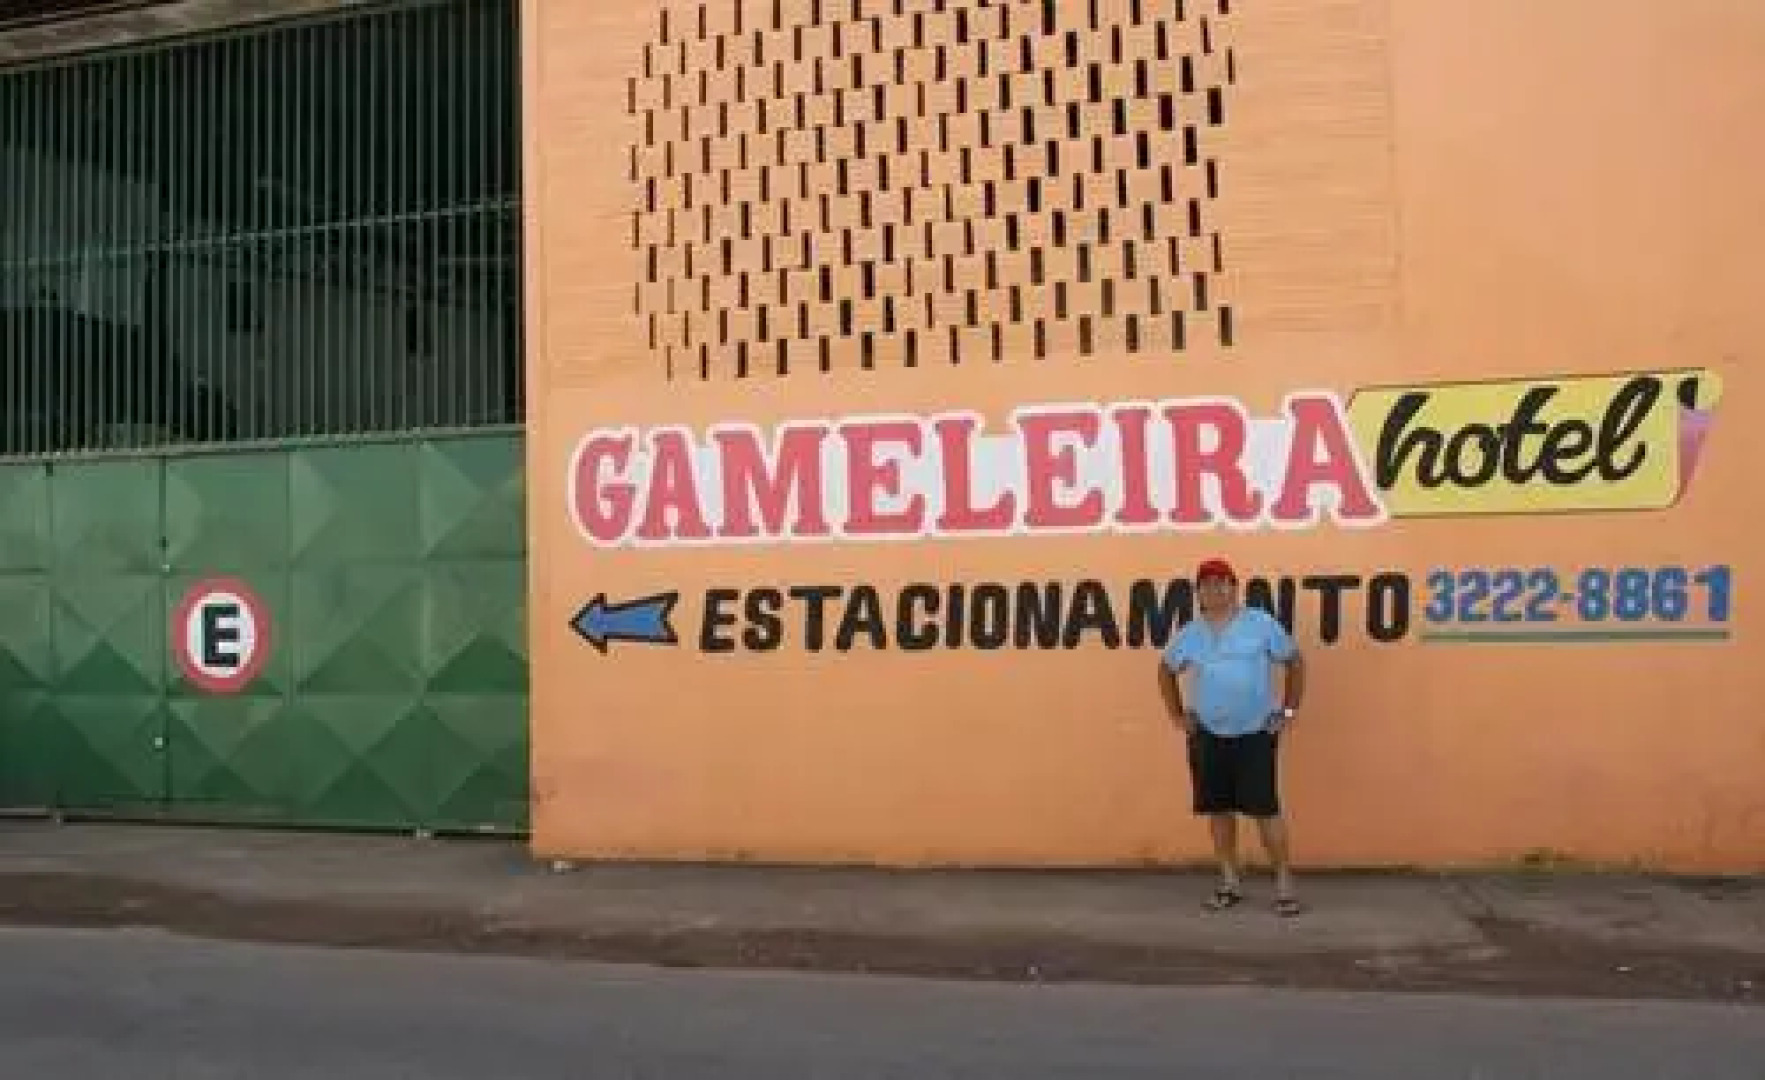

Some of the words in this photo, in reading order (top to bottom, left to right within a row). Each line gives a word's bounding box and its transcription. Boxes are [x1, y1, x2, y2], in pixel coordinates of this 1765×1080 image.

[572, 396, 1382, 542] GAMELEIRA
[1376, 377, 1663, 491] hotel
[199, 602, 241, 668] E
[699, 571, 1411, 653] ESTACIONAMNTO
[1424, 564, 1732, 622] 3222-8861
